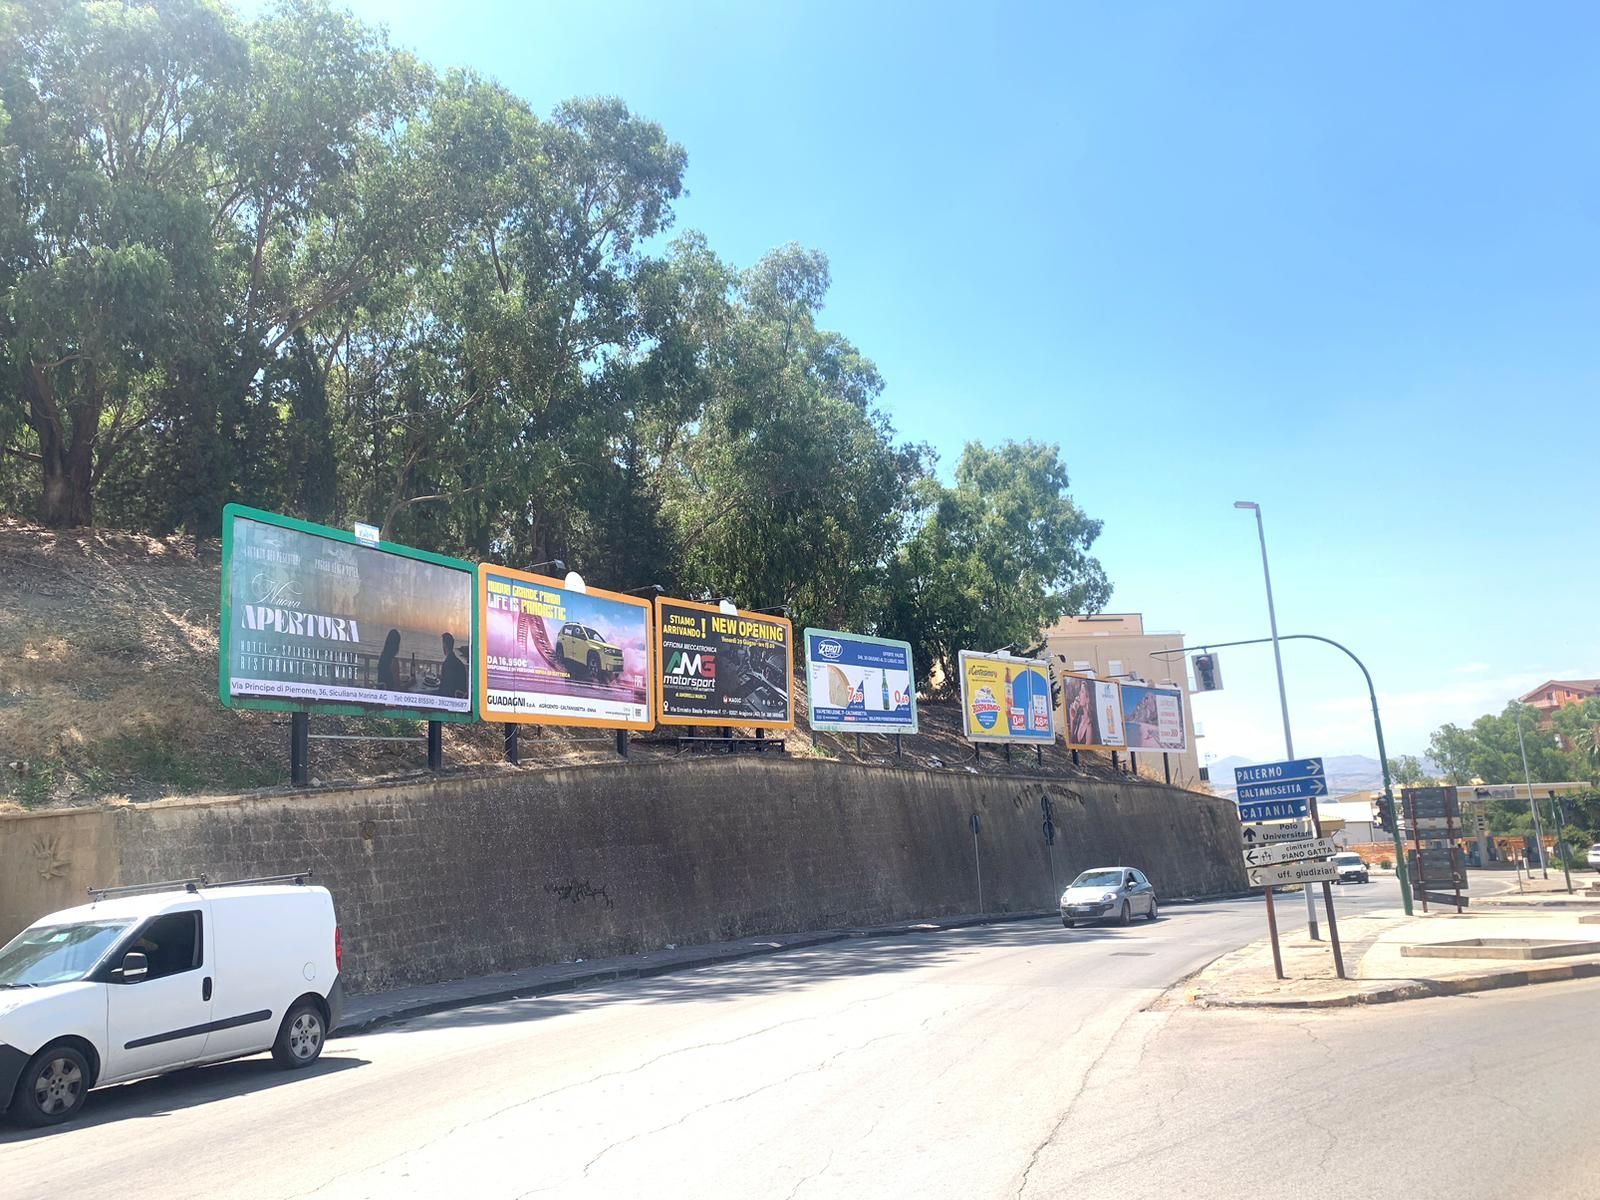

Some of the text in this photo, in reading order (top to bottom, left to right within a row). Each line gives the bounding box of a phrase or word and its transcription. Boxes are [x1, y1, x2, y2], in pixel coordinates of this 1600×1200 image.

[247, 572, 303, 608] Nuova
[488, 592, 509, 611] LIFE
[510, 595, 519, 612] IS
[241, 604, 360, 643] APERTURA
[669, 614, 696, 627] STIAMO
[663, 624, 701, 638] ARRIVANDO
[711, 616, 784, 642] NEW OPENING
[240, 639, 268, 654] HOTEL
[663, 640, 717, 653] OFFICINA MECCATRONICA
[240, 655, 359, 680] RISTORANTE SUL MARE
[487, 655, 498, 667] DA
[665, 651, 716, 678] AMG
[663, 675, 716, 688] motorsport
[231, 682, 243, 690] Via
[245, 682, 275, 693] Principe
[276, 684, 284, 692] di
[285, 685, 317, 696] Piemonte,
[487, 695, 526, 707] GUADAGNI
[1237, 766, 1282, 781] PALERMO
[1240, 783, 1302, 798] CALTANISSETTA
[1242, 804, 1294, 819] CATANIA
[1281, 847, 1333, 860] PIANO GATTA
[1286, 842, 1314, 851] cimitero
[1296, 866, 1336, 878] giudiziari
